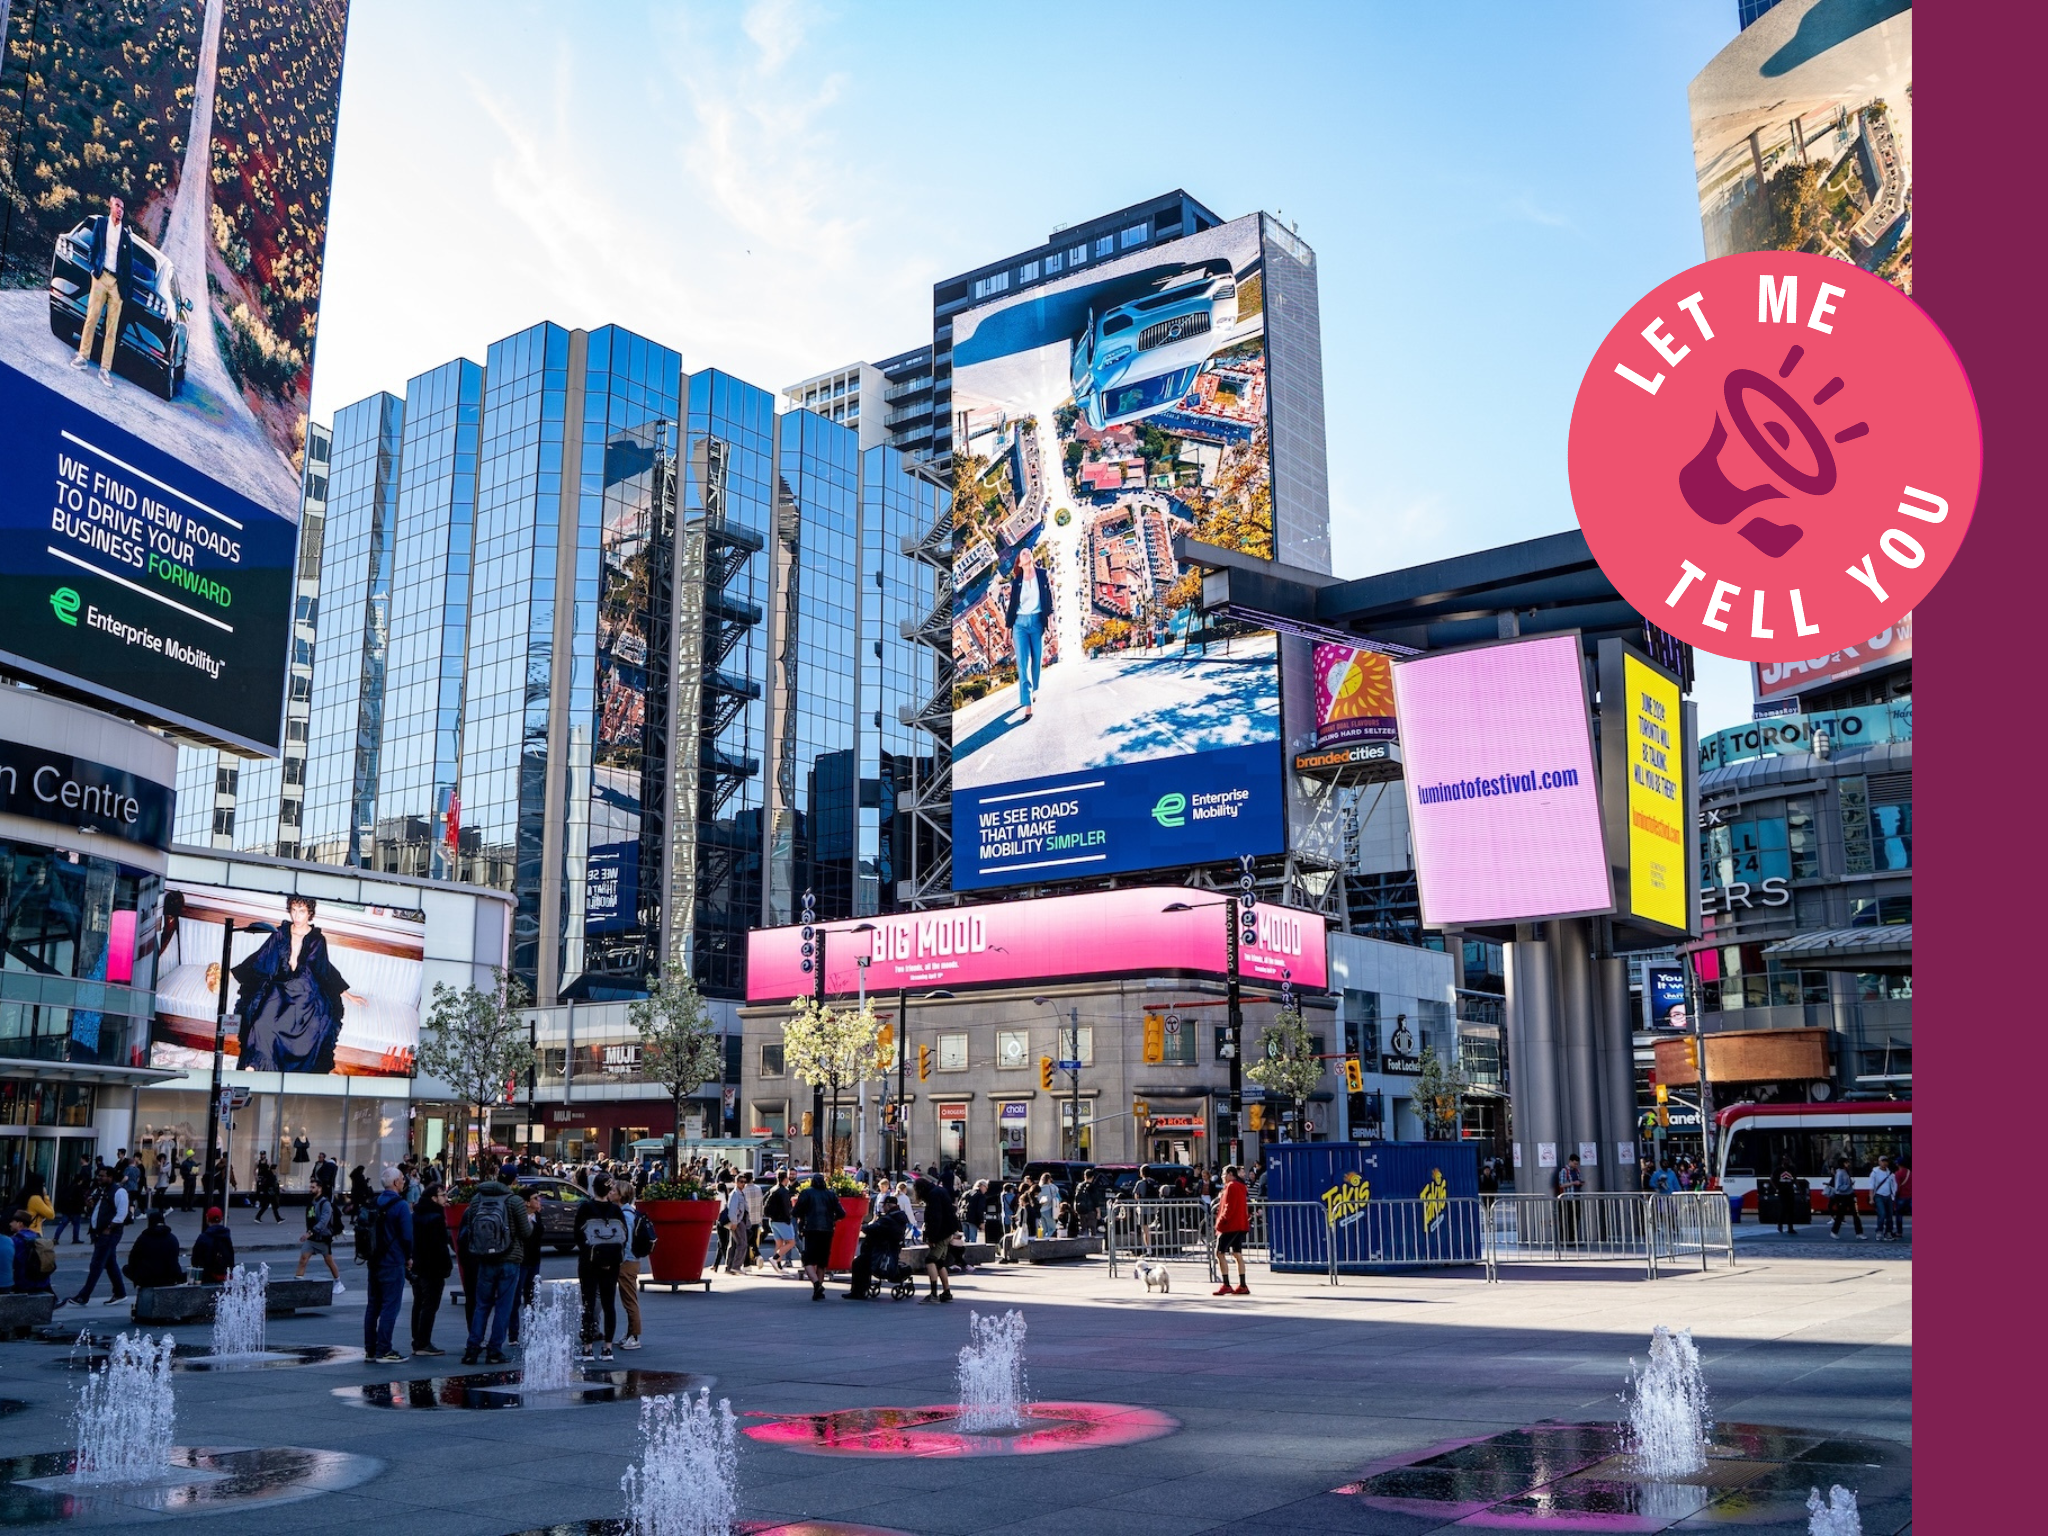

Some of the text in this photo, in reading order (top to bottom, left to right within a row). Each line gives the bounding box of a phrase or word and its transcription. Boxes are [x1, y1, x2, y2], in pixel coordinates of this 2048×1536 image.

[56, 480, 195, 566] TO DRIVE YOUR
[59, 453, 241, 563] WE FIND NEW ROADS
[52, 507, 232, 608] BUSINESS FORWARD
[86, 604, 162, 655] Enterprise
[1730, 716, 1863, 753] TORONTO
[1296, 746, 1385, 769] brandedcities
[33, 766, 139, 824] Centre
[1192, 789, 1249, 806] Enterprise
[1418, 768, 1579, 805] luminatofestival.com
[979, 800, 1079, 828] WE SEE ROADS
[980, 820, 1056, 844] THAT MAKE
[980, 830, 1106, 860] MOBILITY SIMPLER
[1240, 854, 1256, 946] Yonge
[871, 913, 987, 962] BIG MOOD
[1257, 911, 1302, 956] MOOD
[1657, 973, 1683, 983] You
[606, 1045, 636, 1064] MUJI
[1388, 1058, 1401, 1070] Foot
[831, 1110, 845, 1120] fdo
[1006, 1105, 1025, 1114] chatr
[1321, 1174, 1370, 1228] Takis
